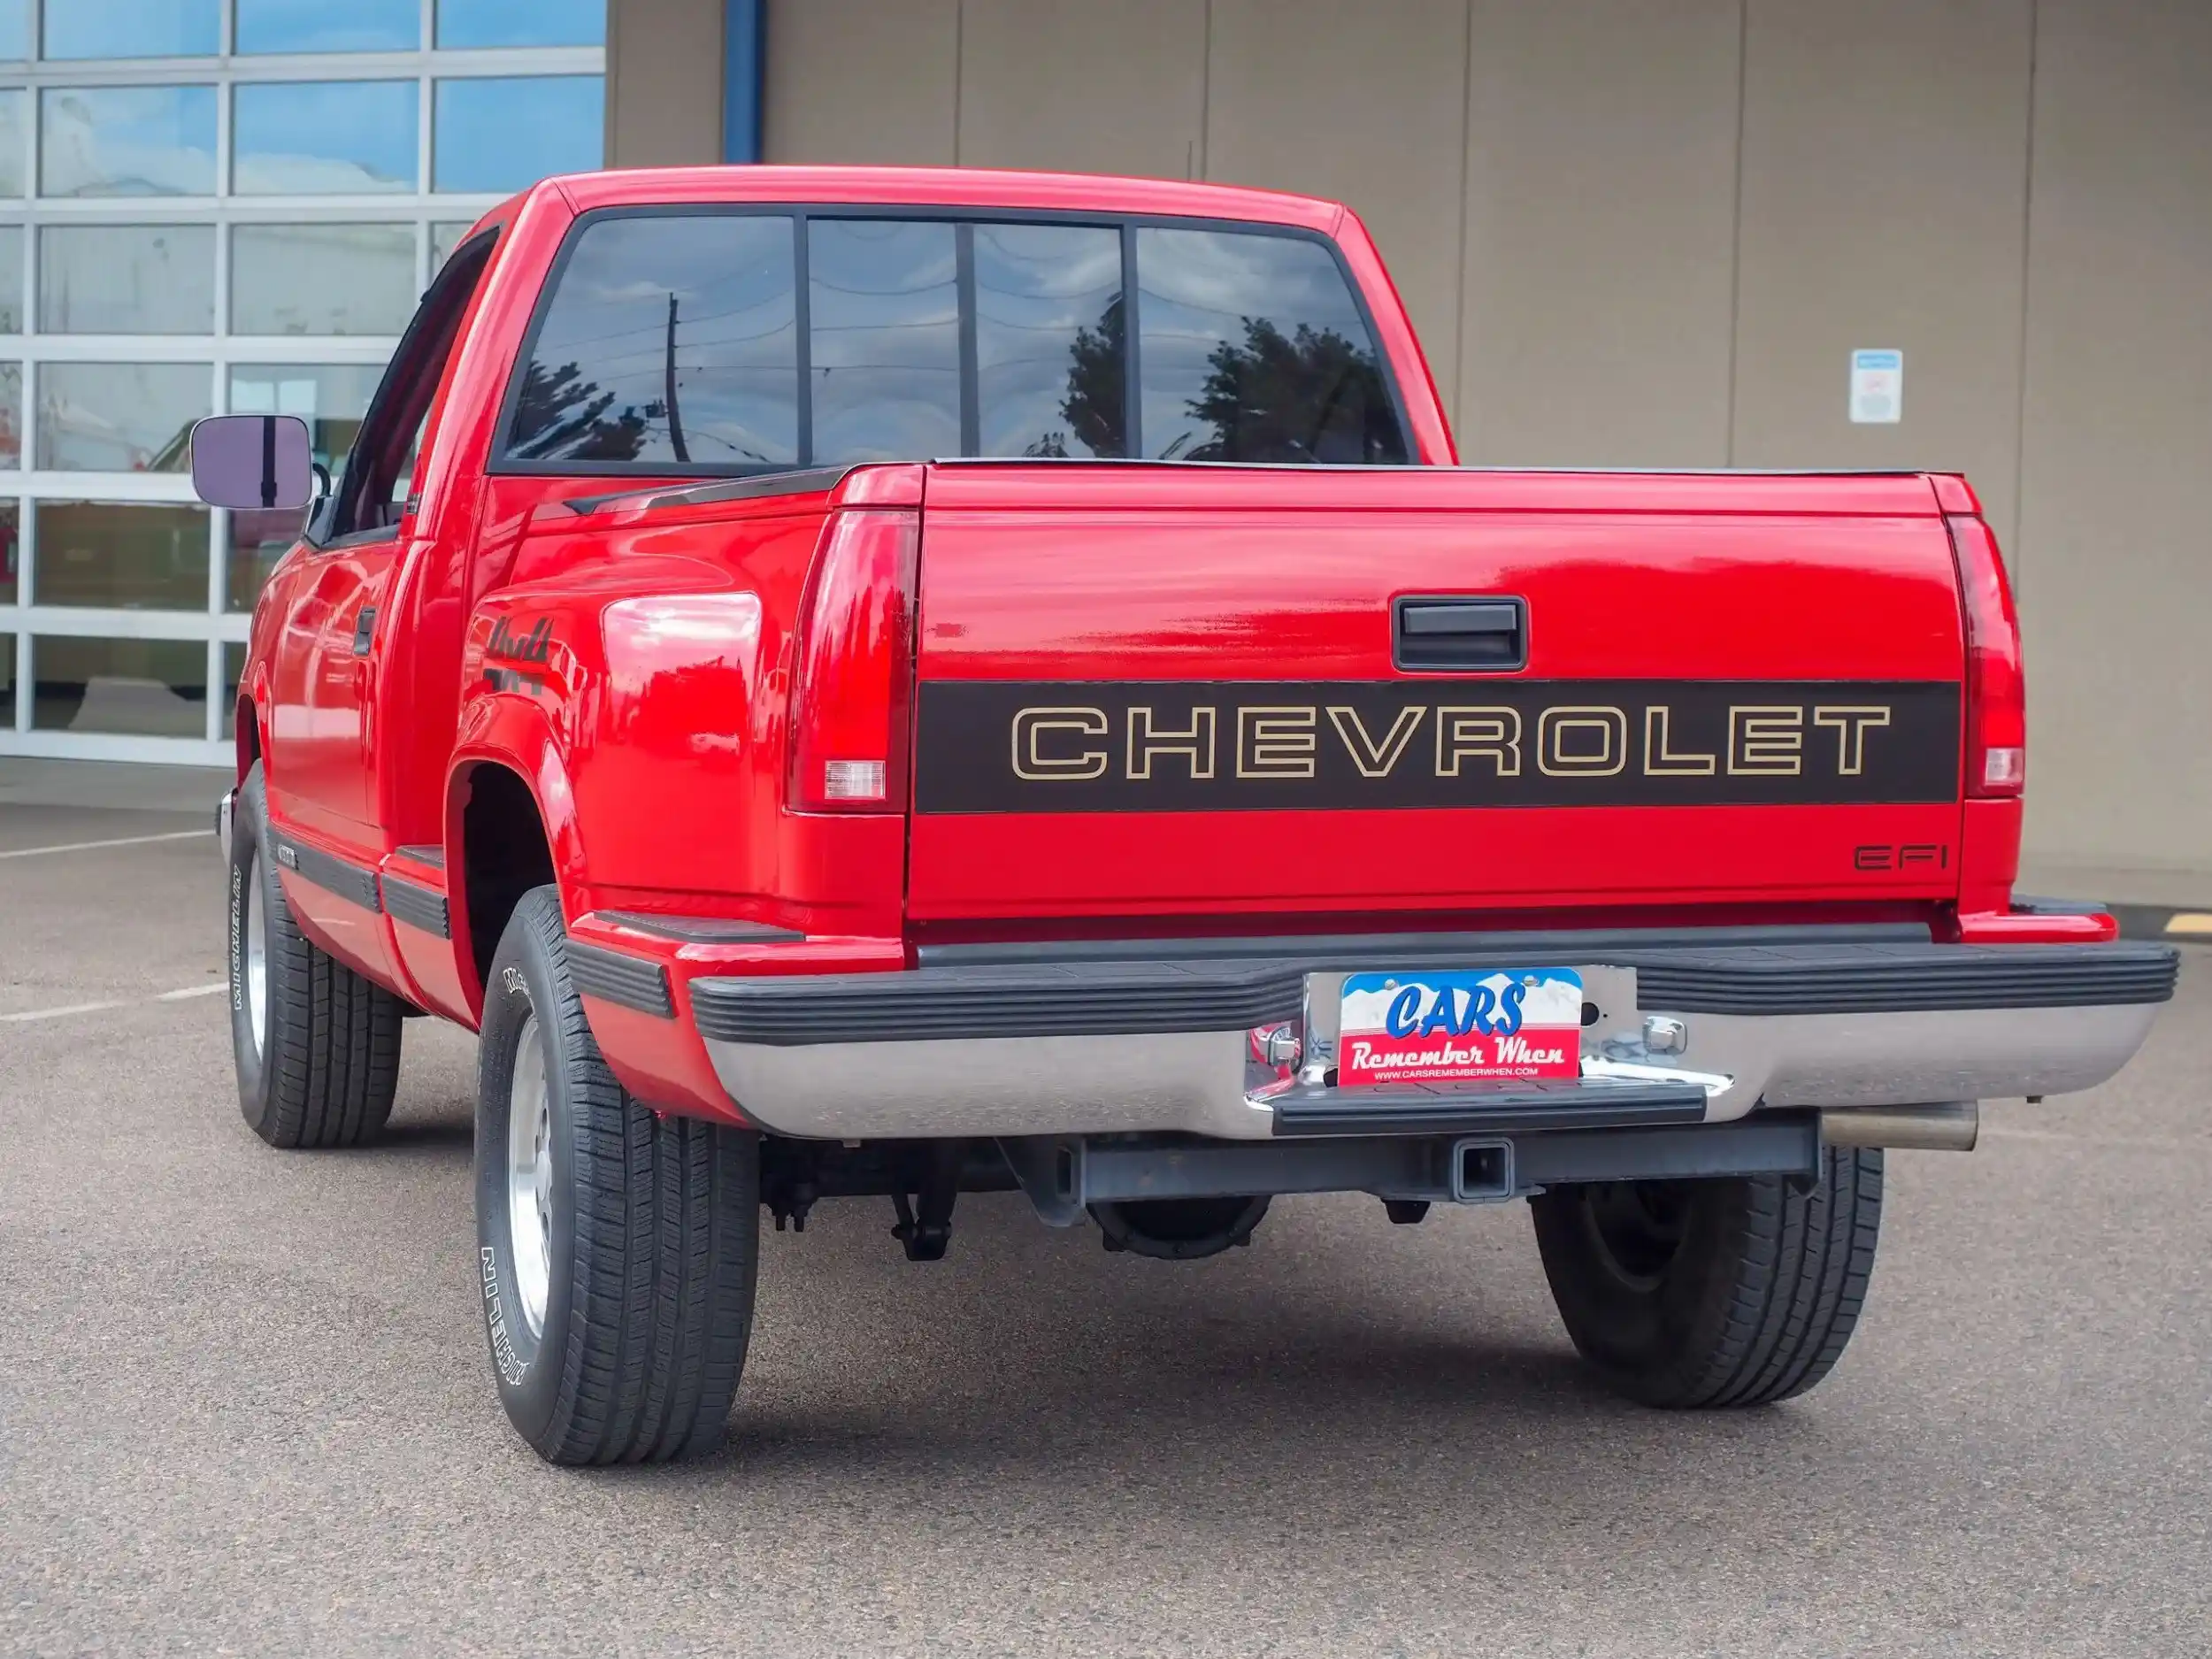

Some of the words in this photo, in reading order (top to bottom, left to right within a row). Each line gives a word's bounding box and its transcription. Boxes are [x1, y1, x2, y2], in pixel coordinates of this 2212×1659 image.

[1010, 704, 1891, 780] CHEVROLET
[1855, 845, 1947, 871] EFI
[232, 864, 242, 1010] MICHELIN
[1386, 982, 1526, 1039] CARS
[1352, 1041, 1485, 1070] Remember
[1495, 1037, 1565, 1064] When
[1375, 1068, 1538, 1080] WWW.CARSREMEMBERWHEN.COM
[480, 1247, 529, 1386] MICHELIN
